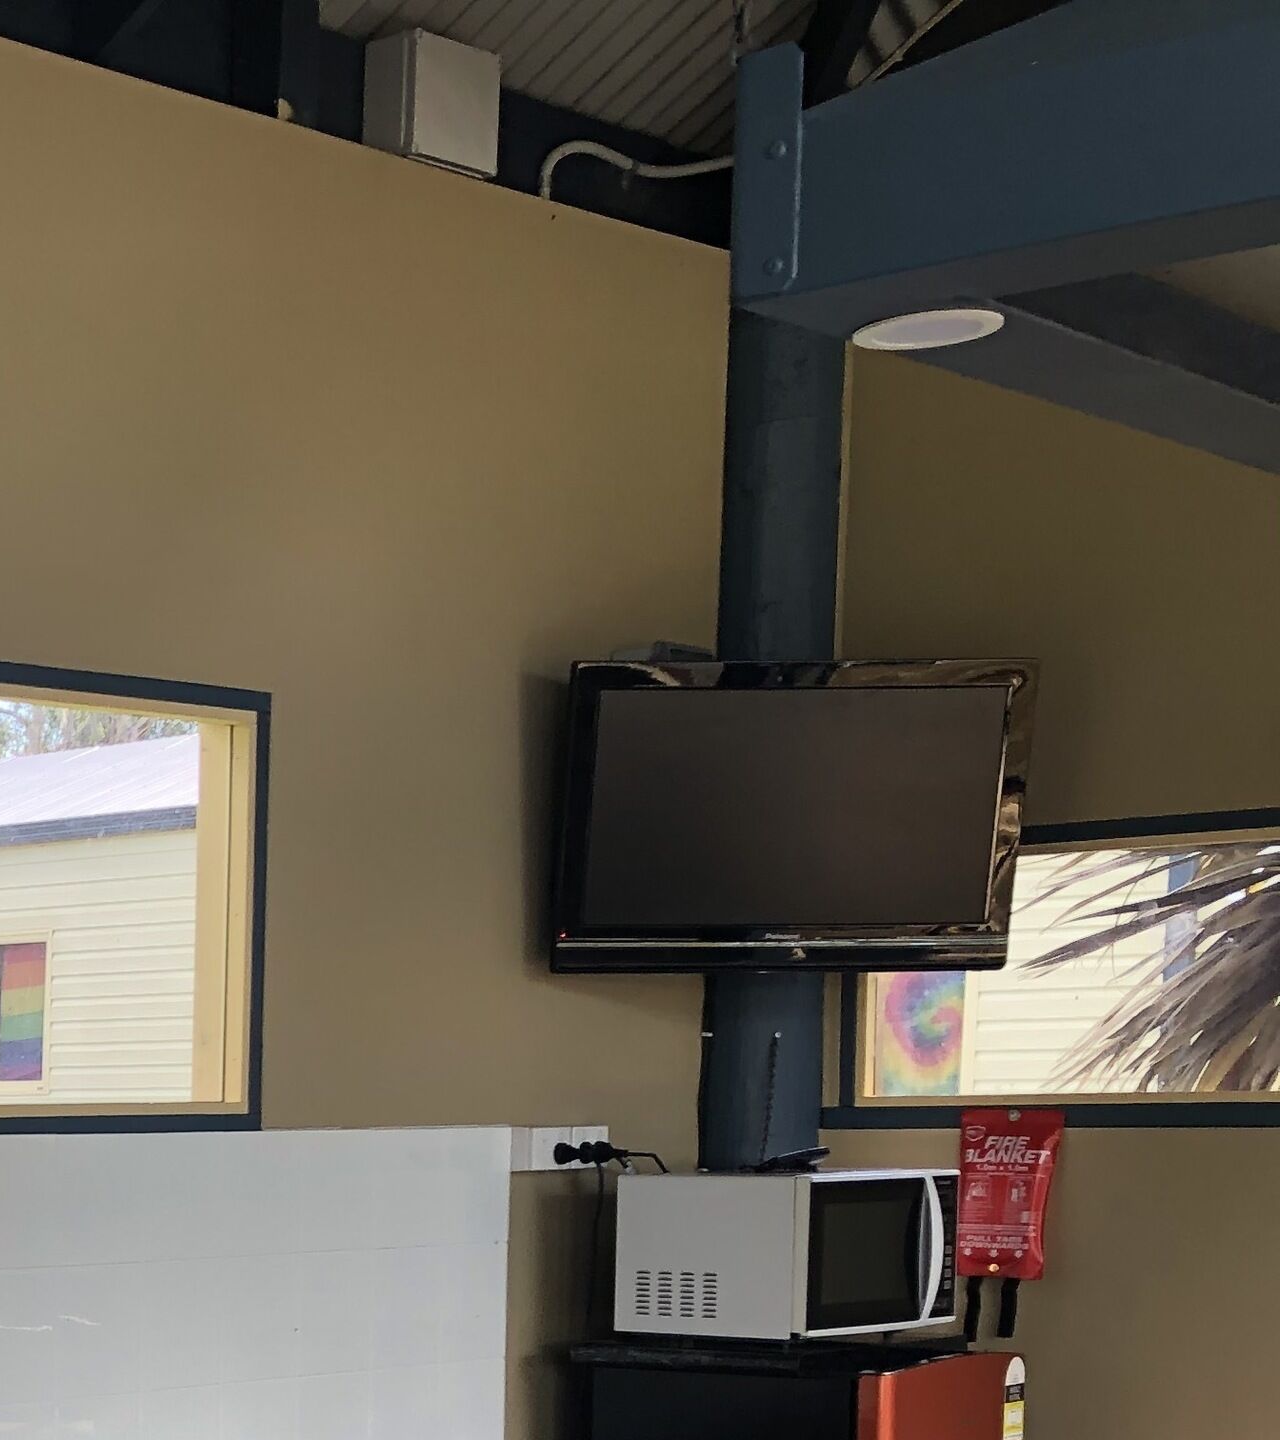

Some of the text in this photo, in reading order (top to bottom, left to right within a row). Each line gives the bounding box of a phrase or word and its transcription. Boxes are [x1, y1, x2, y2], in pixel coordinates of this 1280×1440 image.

[984, 1136, 1031, 1150] FIRE
[965, 1149, 1051, 1165] BLANKET
[959, 1241, 1030, 1250] DOWNWARDS
